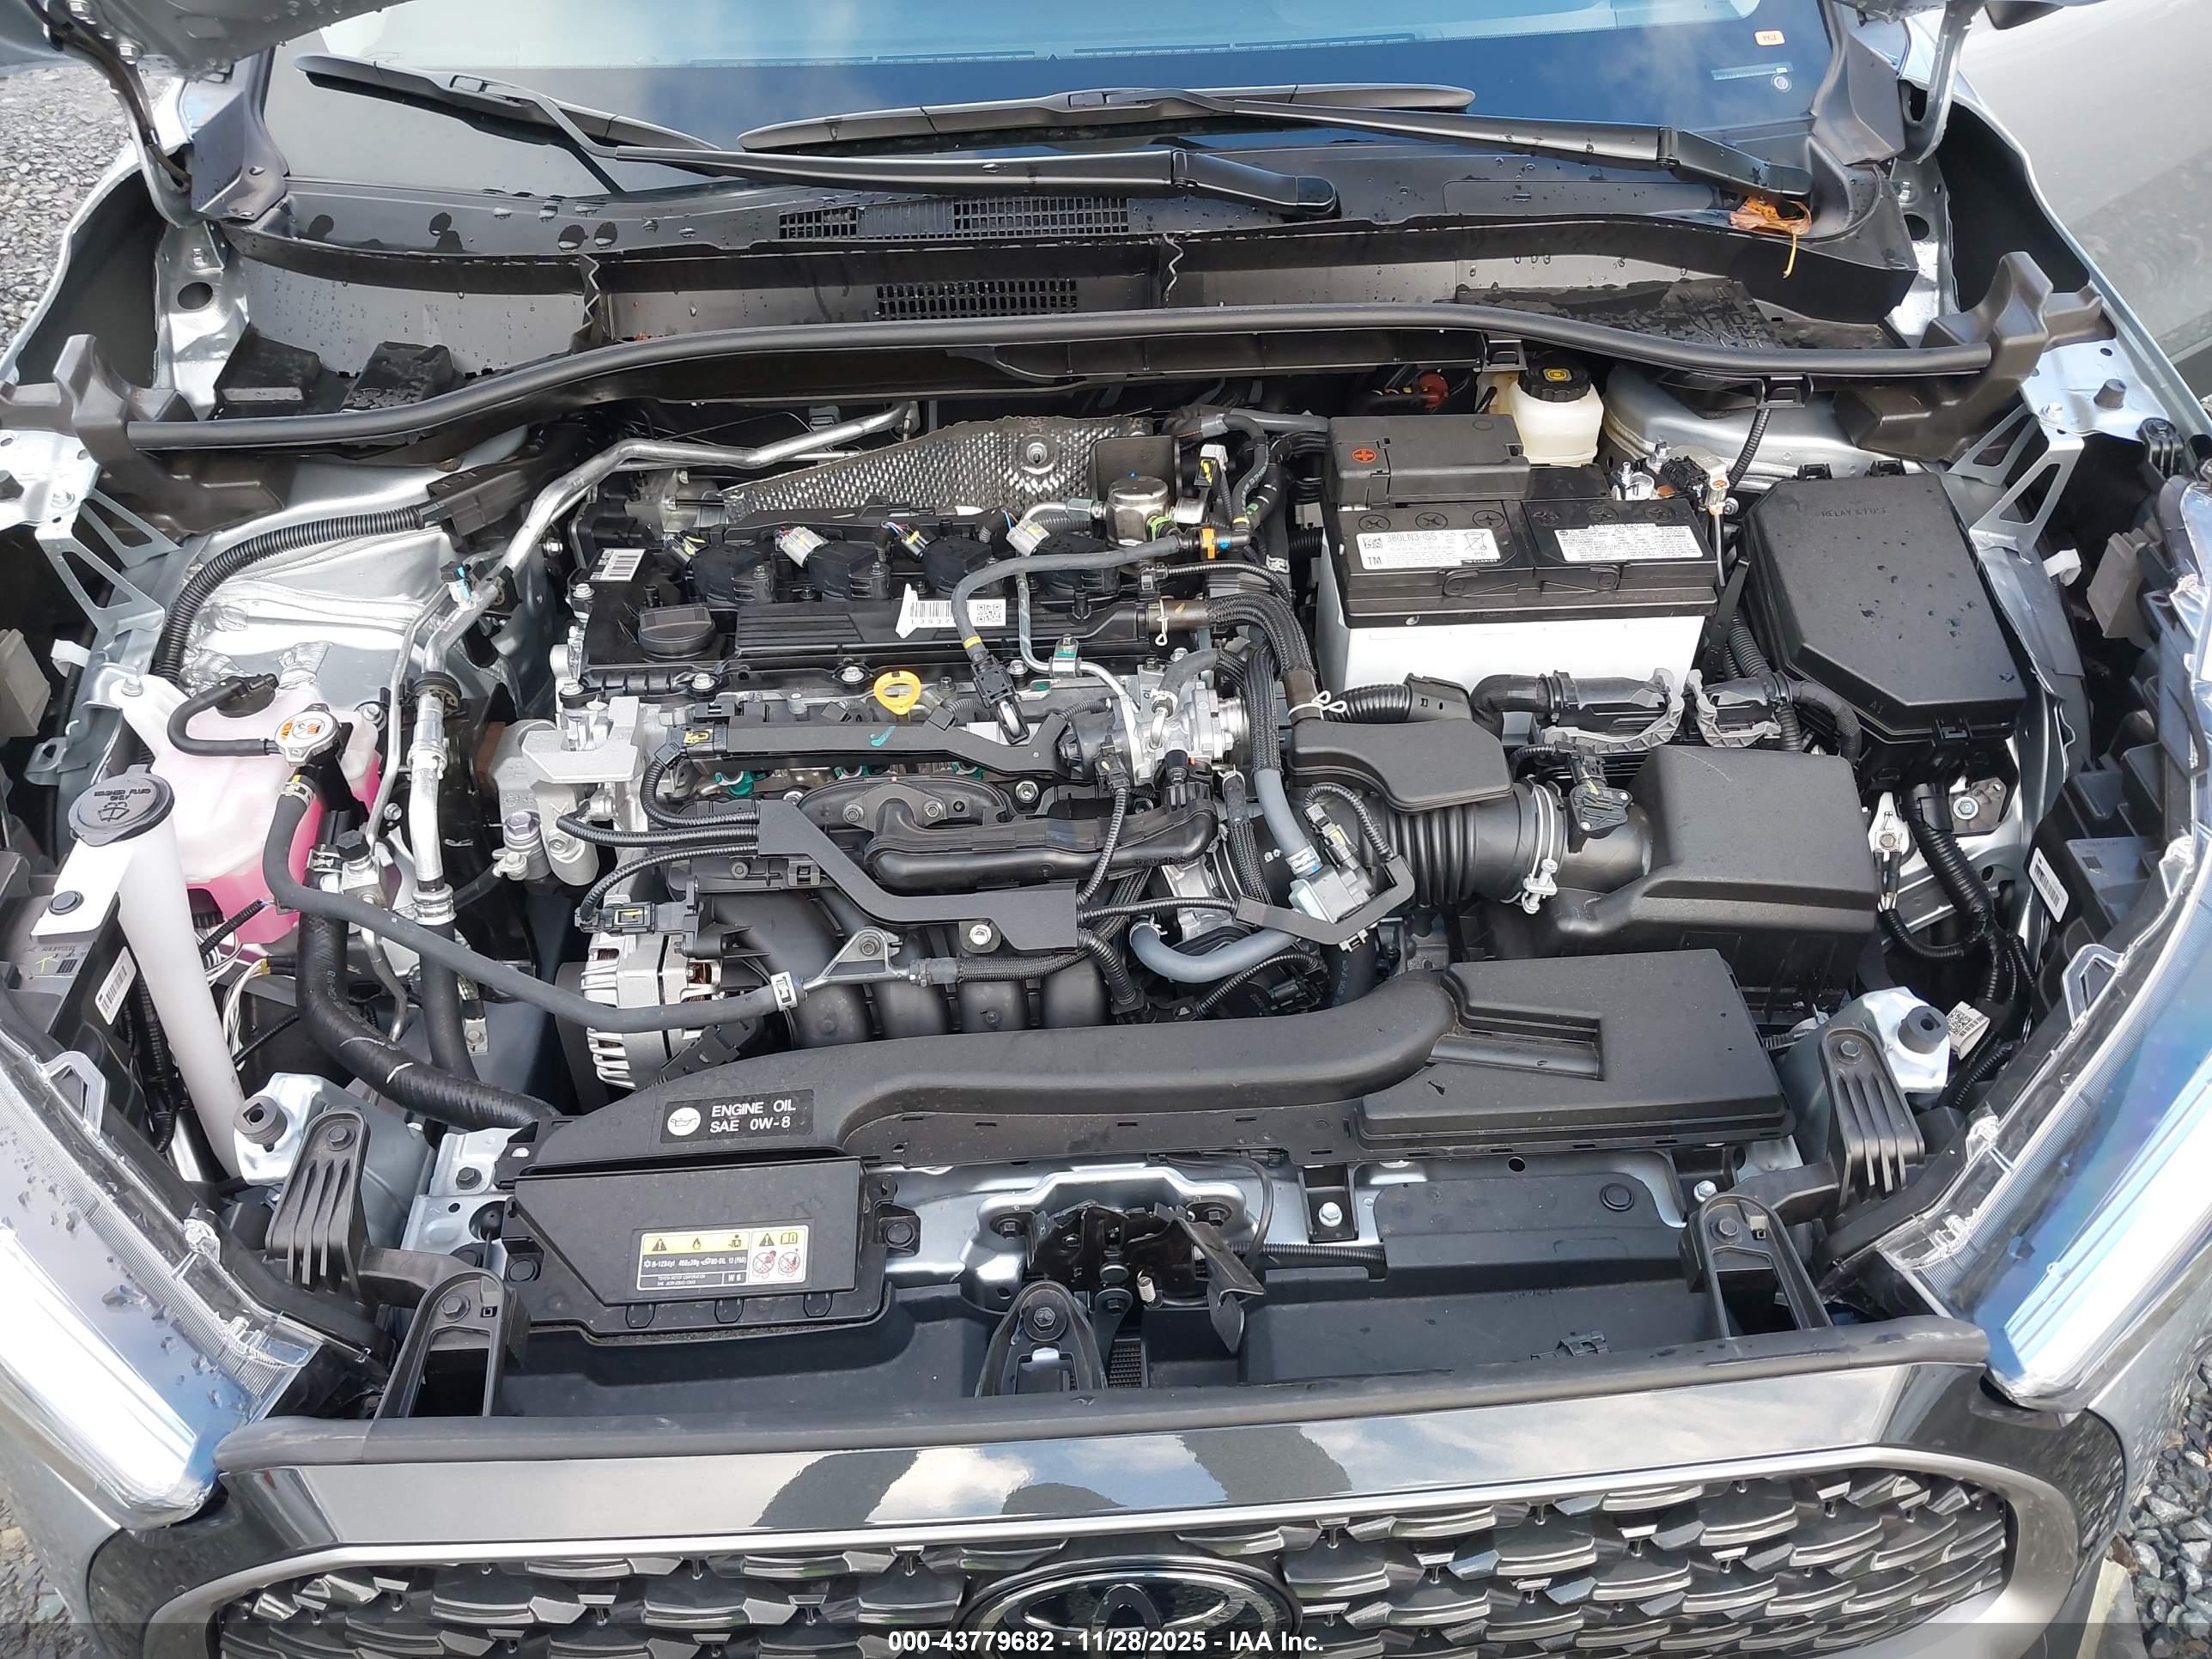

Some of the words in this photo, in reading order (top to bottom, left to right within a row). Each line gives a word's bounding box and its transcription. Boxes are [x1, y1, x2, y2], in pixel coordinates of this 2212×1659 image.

[1367, 556, 1382, 566] TM
[711, 1102, 764, 1117] ENGINE
[773, 1098, 797, 1112] OIL
[709, 1119, 740, 1133] SAE
[750, 1115, 791, 1131] 0W-8
[728, 1273, 735, 1282] W
